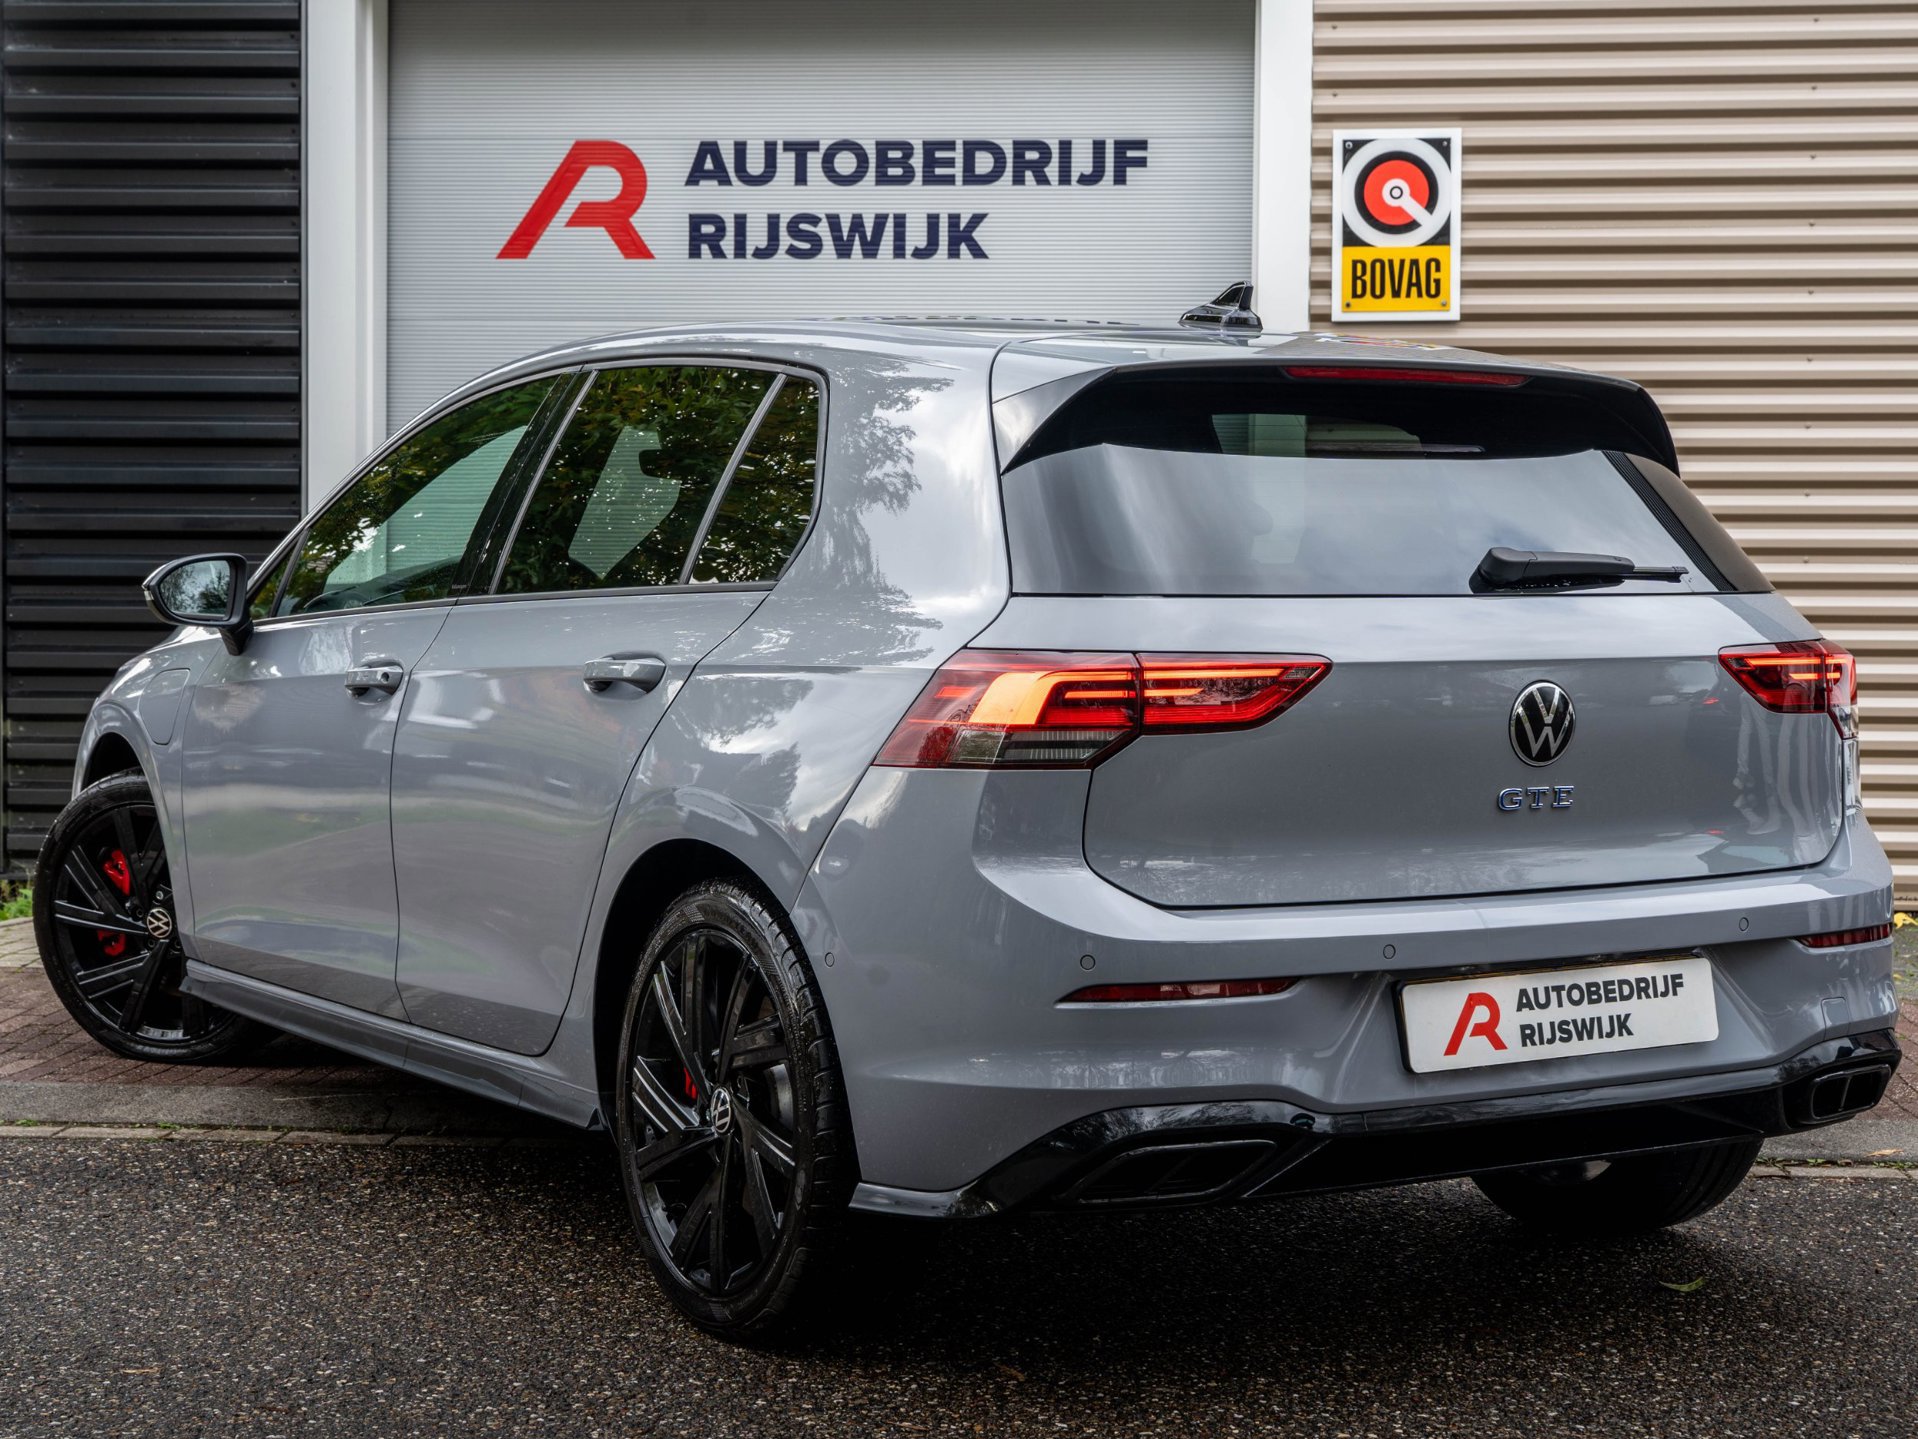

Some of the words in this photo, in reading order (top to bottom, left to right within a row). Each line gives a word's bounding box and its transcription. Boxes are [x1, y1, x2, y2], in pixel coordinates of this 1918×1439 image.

[685, 138, 1149, 187] AUTOBEDRIJF
[687, 212, 990, 259] RIJSWIJK
[1351, 257, 1441, 299] BOVAG
[1498, 785, 1574, 811] GTE
[1516, 973, 1684, 1012] AUTOBEDRIJF
[1519, 1013, 1634, 1048] RIJSWIJK
